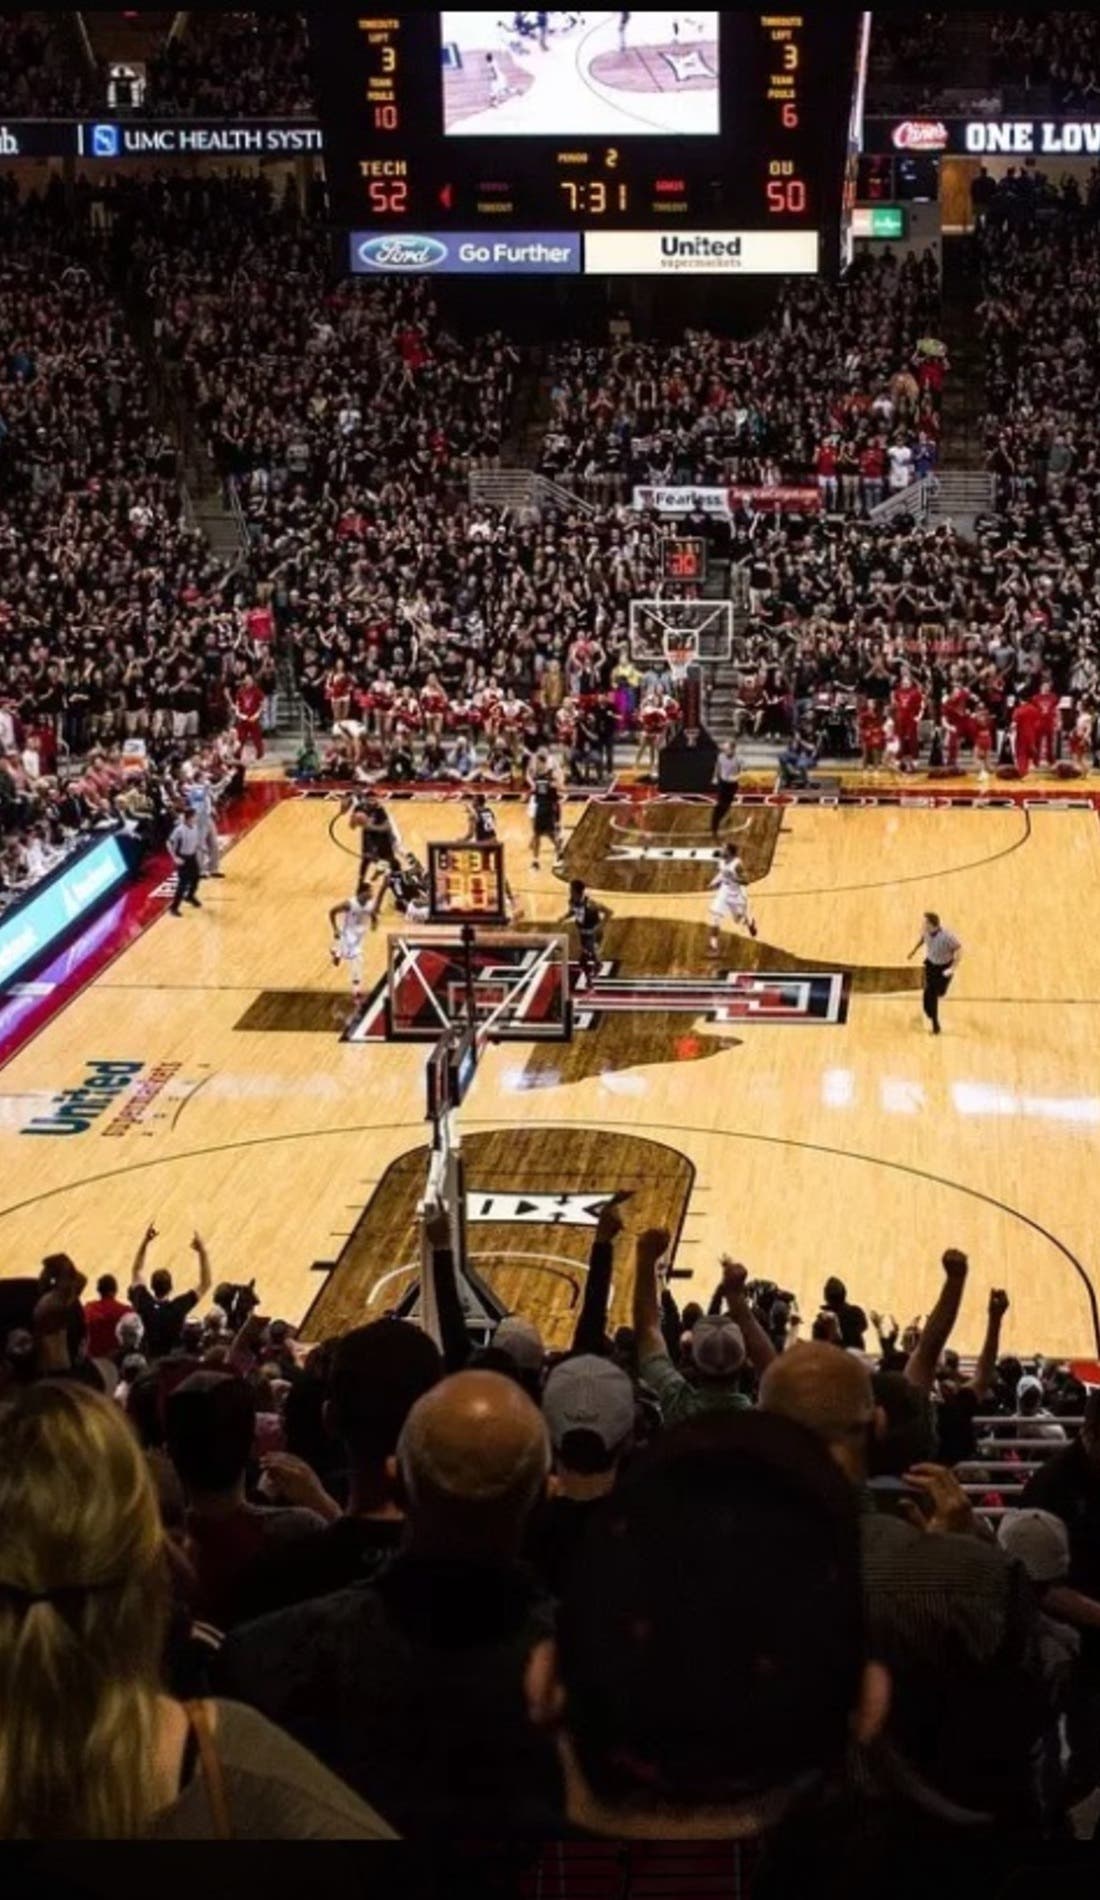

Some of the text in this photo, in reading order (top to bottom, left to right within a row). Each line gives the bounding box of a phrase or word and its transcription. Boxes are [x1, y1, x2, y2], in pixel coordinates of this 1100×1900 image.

[382, 47, 396, 72] 3
[784, 44, 798, 69] 3
[375, 106, 397, 128] 10
[783, 103, 798, 128] 6
[124, 130, 175, 149] UMC
[180, 130, 262, 149] HEALTH
[966, 122, 1034, 152] ONE
[359, 160, 407, 177] TECH
[605, 148, 619, 168] 2
[768, 161, 794, 176] OU
[370, 182, 407, 212] 52
[560, 182, 627, 213] 7:31
[766, 181, 806, 212] 50
[459, 243, 572, 262] Go Further
[660, 236, 742, 256] United
[19, 1060, 145, 1135] United
